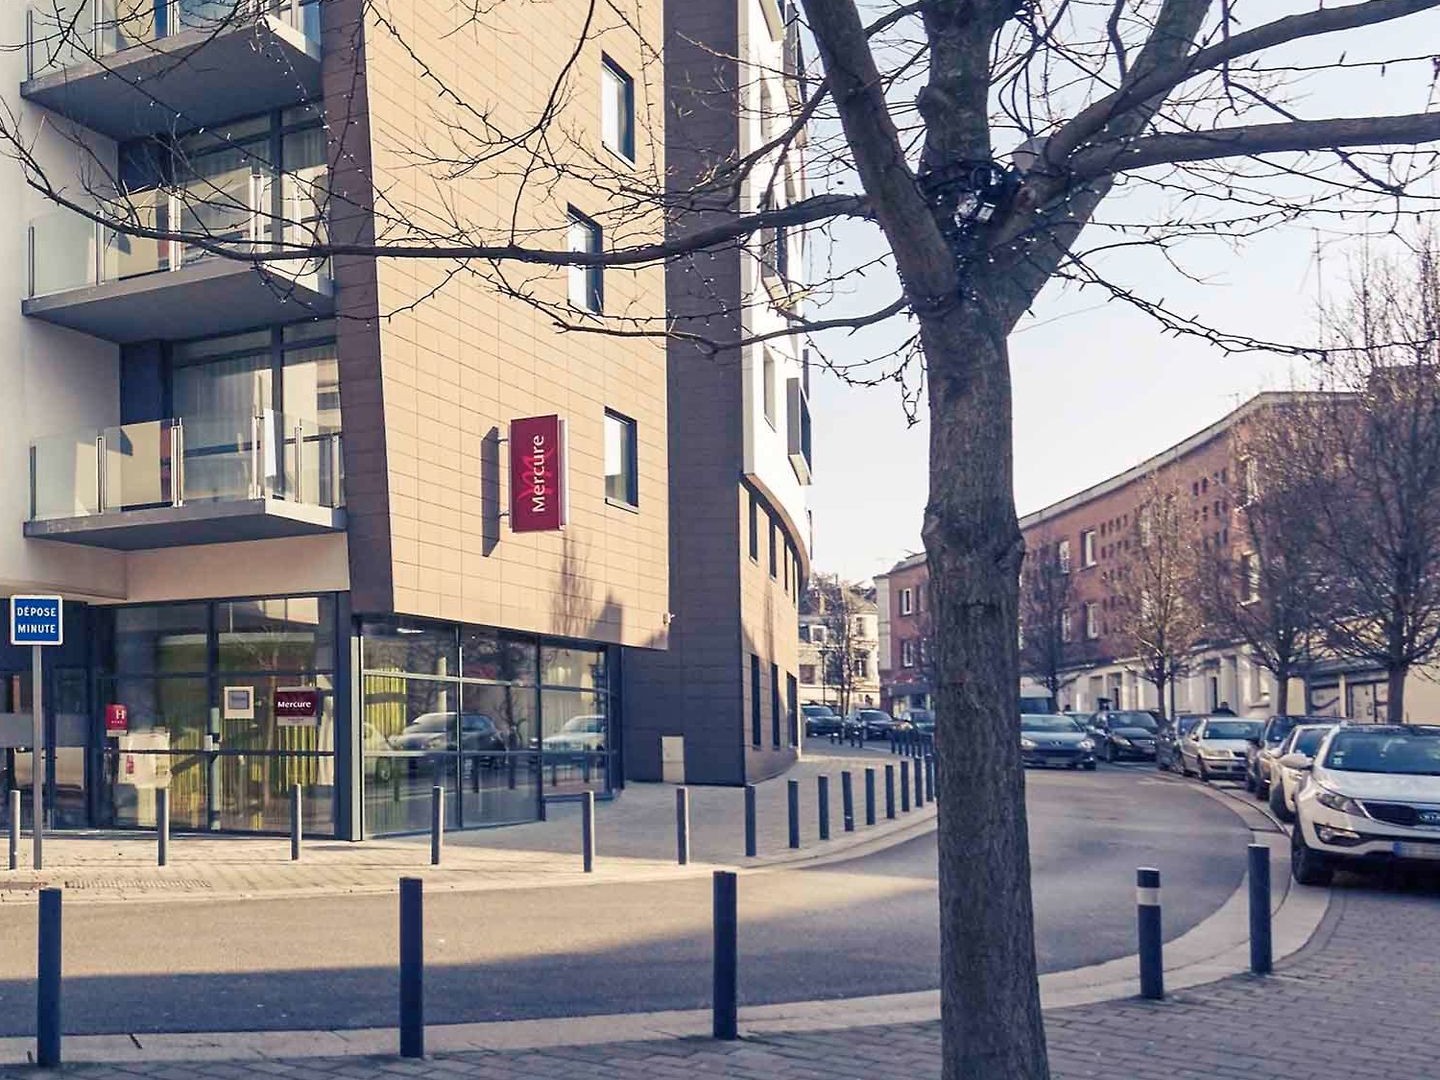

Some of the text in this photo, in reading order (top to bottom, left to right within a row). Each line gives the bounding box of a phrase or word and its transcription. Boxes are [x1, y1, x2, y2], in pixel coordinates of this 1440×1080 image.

[532, 435, 545, 513] Mercure
[17, 605, 57, 617] DÉPOSE
[17, 624, 56, 634] MINUTE
[277, 701, 312, 709] Mercure
